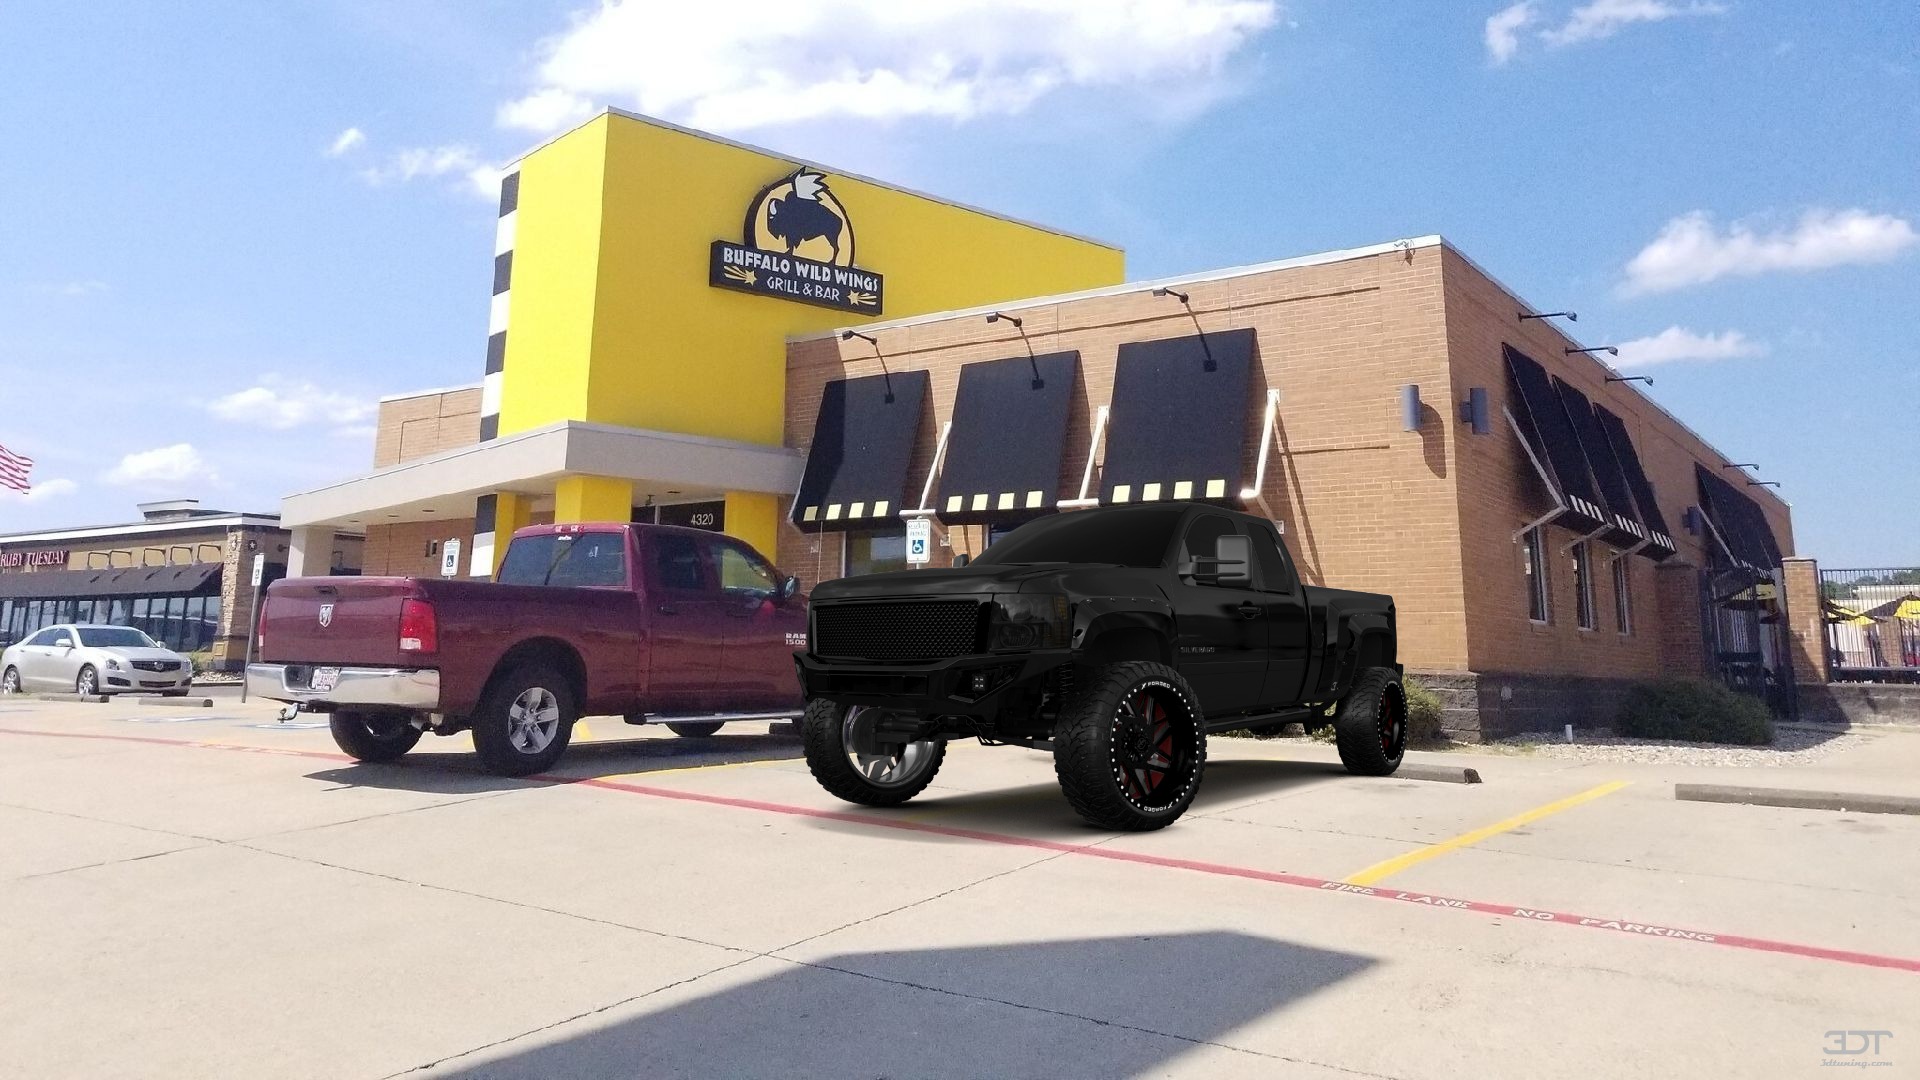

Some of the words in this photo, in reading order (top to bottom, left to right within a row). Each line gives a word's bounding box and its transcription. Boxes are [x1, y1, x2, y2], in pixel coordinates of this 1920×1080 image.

[723, 247, 790, 274] BUFFALO
[795, 261, 831, 282] WILD
[834, 268, 878, 292] WINGS
[766, 276, 800, 295] GRILL
[802, 282, 812, 297] &
[815, 284, 840, 302] BAR
[690, 513, 714, 526] 4320
[0, 552, 23, 567] RUBY
[26, 550, 67, 566] TUESDAY
[1320, 881, 1376, 896] FIRE
[1394, 892, 1472, 909] LANE
[1513, 907, 1555, 921] NO
[1579, 917, 1716, 944] PARKING
